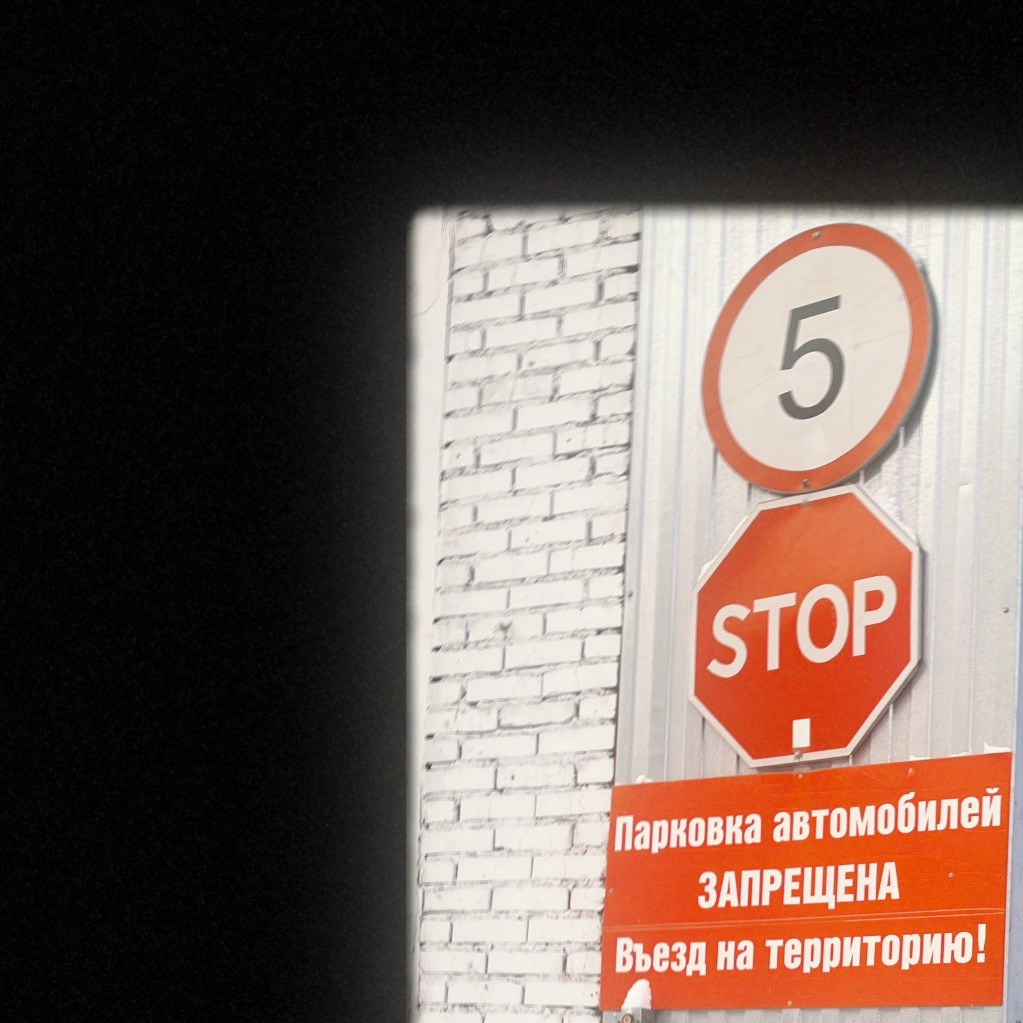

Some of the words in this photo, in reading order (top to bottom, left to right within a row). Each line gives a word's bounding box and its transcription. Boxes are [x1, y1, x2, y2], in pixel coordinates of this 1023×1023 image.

[777, 294, 846, 421] 5
[706, 574, 898, 679] STOP
[614, 813, 763, 854] Парковка
[772, 787, 1003, 843] автомобилей
[697, 861, 901, 910] ЗАПРЕЩЕНА
[615, 936, 708, 977] Въезд
[716, 939, 755, 971] на
[765, 923, 988, 974] территорию!
